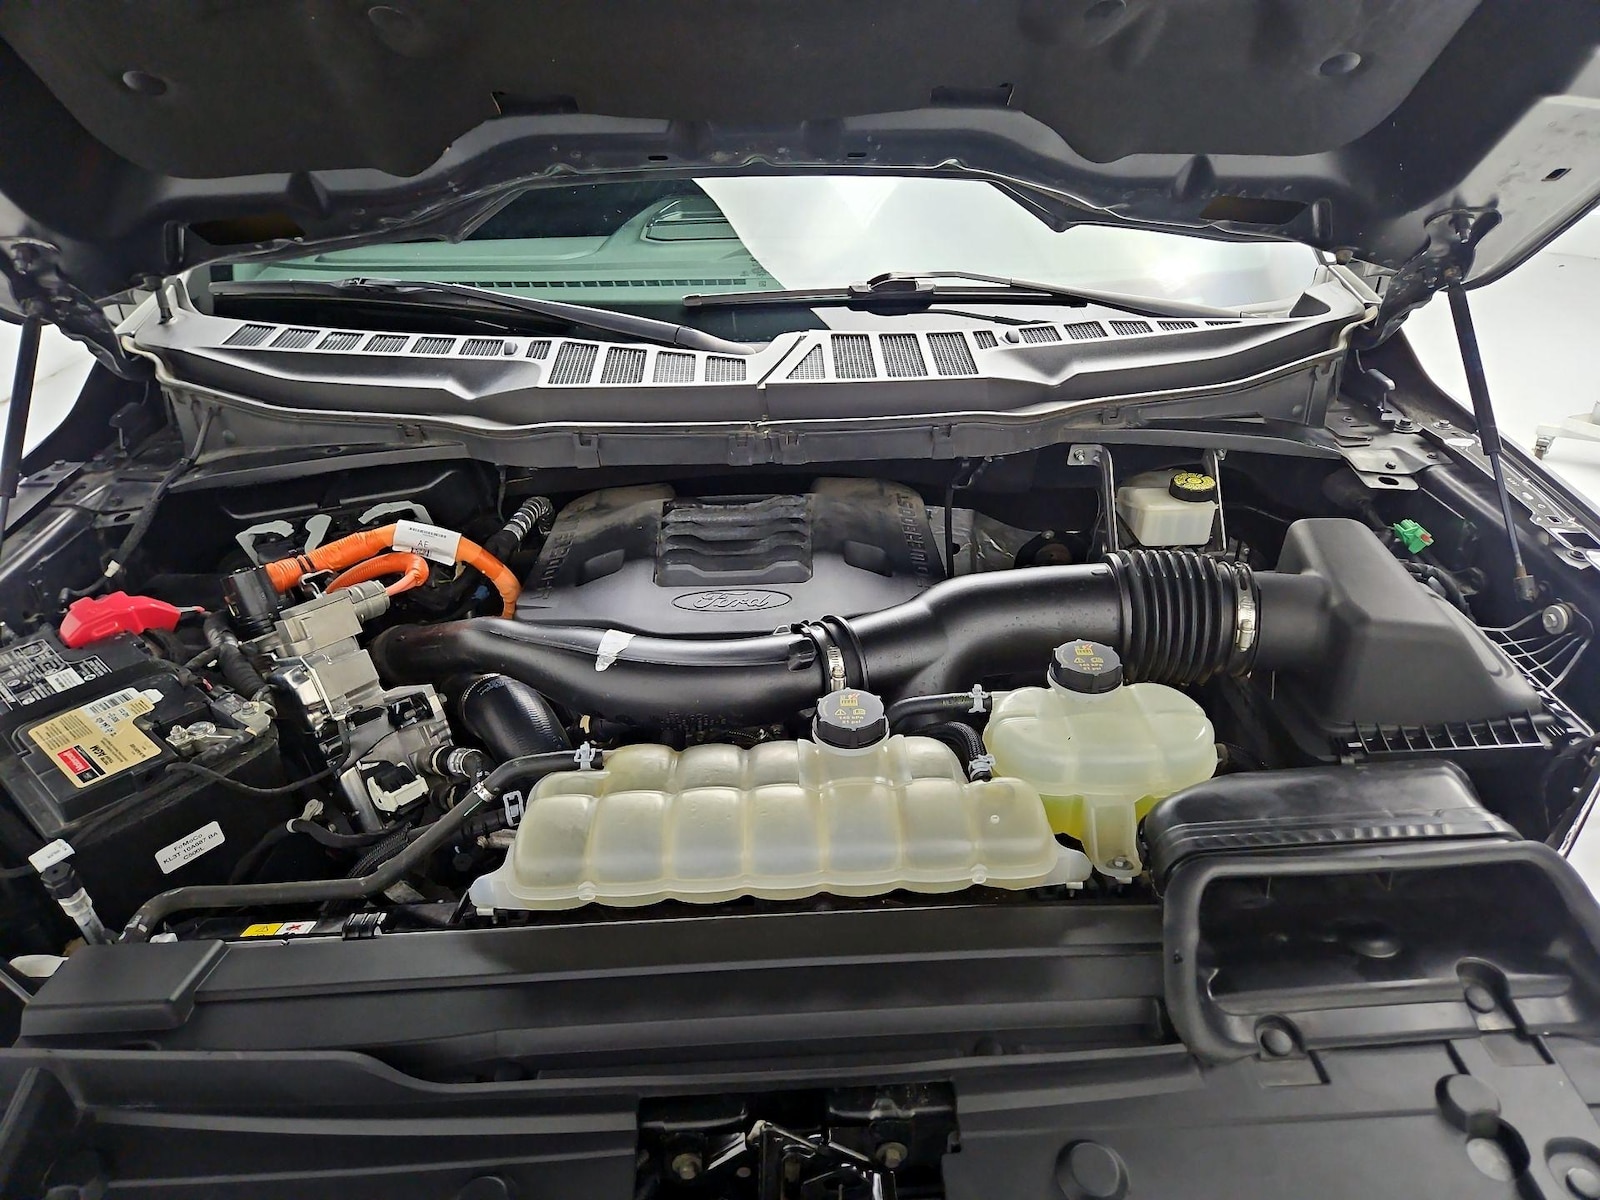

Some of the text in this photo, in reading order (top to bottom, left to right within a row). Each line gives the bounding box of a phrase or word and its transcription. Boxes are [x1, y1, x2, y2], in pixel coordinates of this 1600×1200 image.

[693, 591, 771, 609] Ford
[90, 744, 106, 758] AGM
[163, 852, 181, 864] KL3T
[207, 832, 218, 840] BA
[173, 833, 203, 851] FoMoCo
